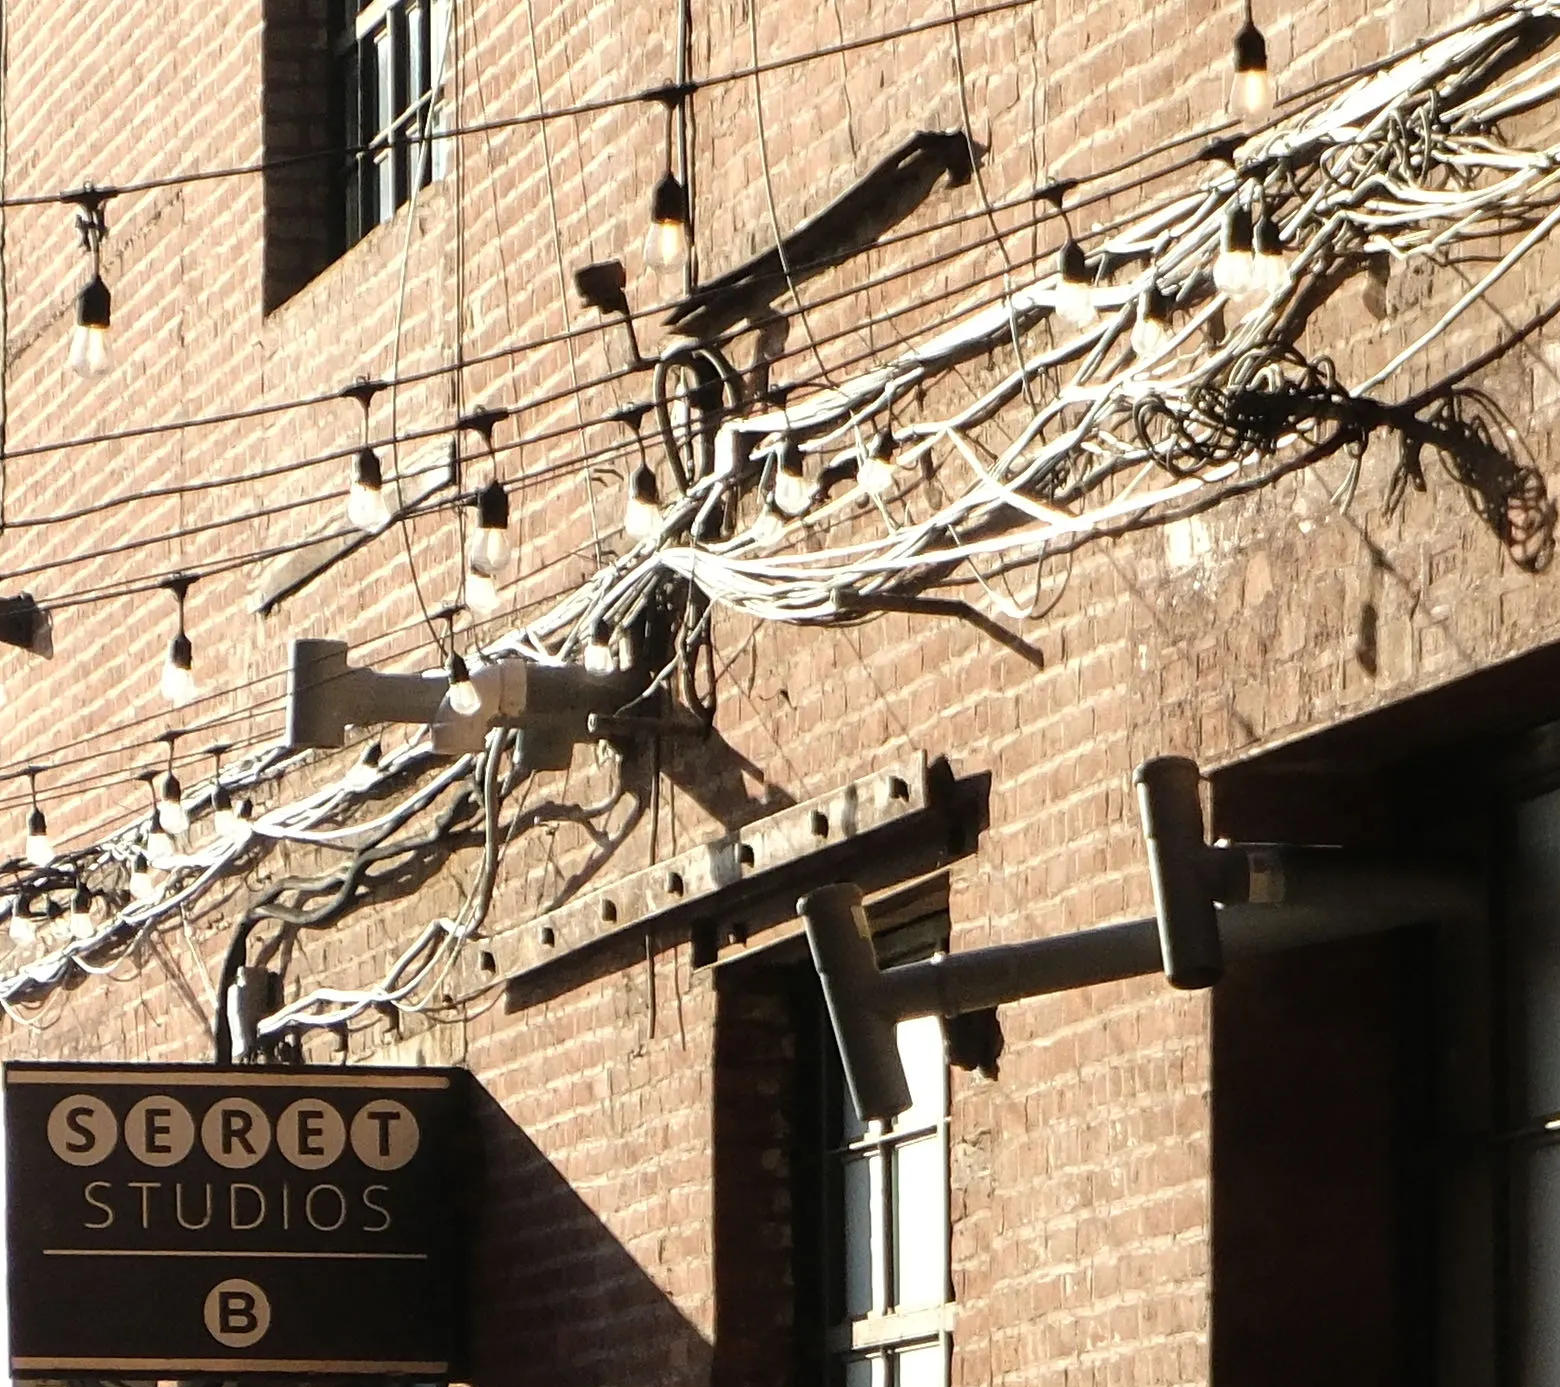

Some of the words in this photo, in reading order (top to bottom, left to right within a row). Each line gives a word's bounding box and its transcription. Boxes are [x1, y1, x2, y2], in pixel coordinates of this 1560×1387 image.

[63, 1104, 403, 1159] SERET
[82, 1181, 393, 1232] STUDIOS
[214, 1287, 262, 1339] B
